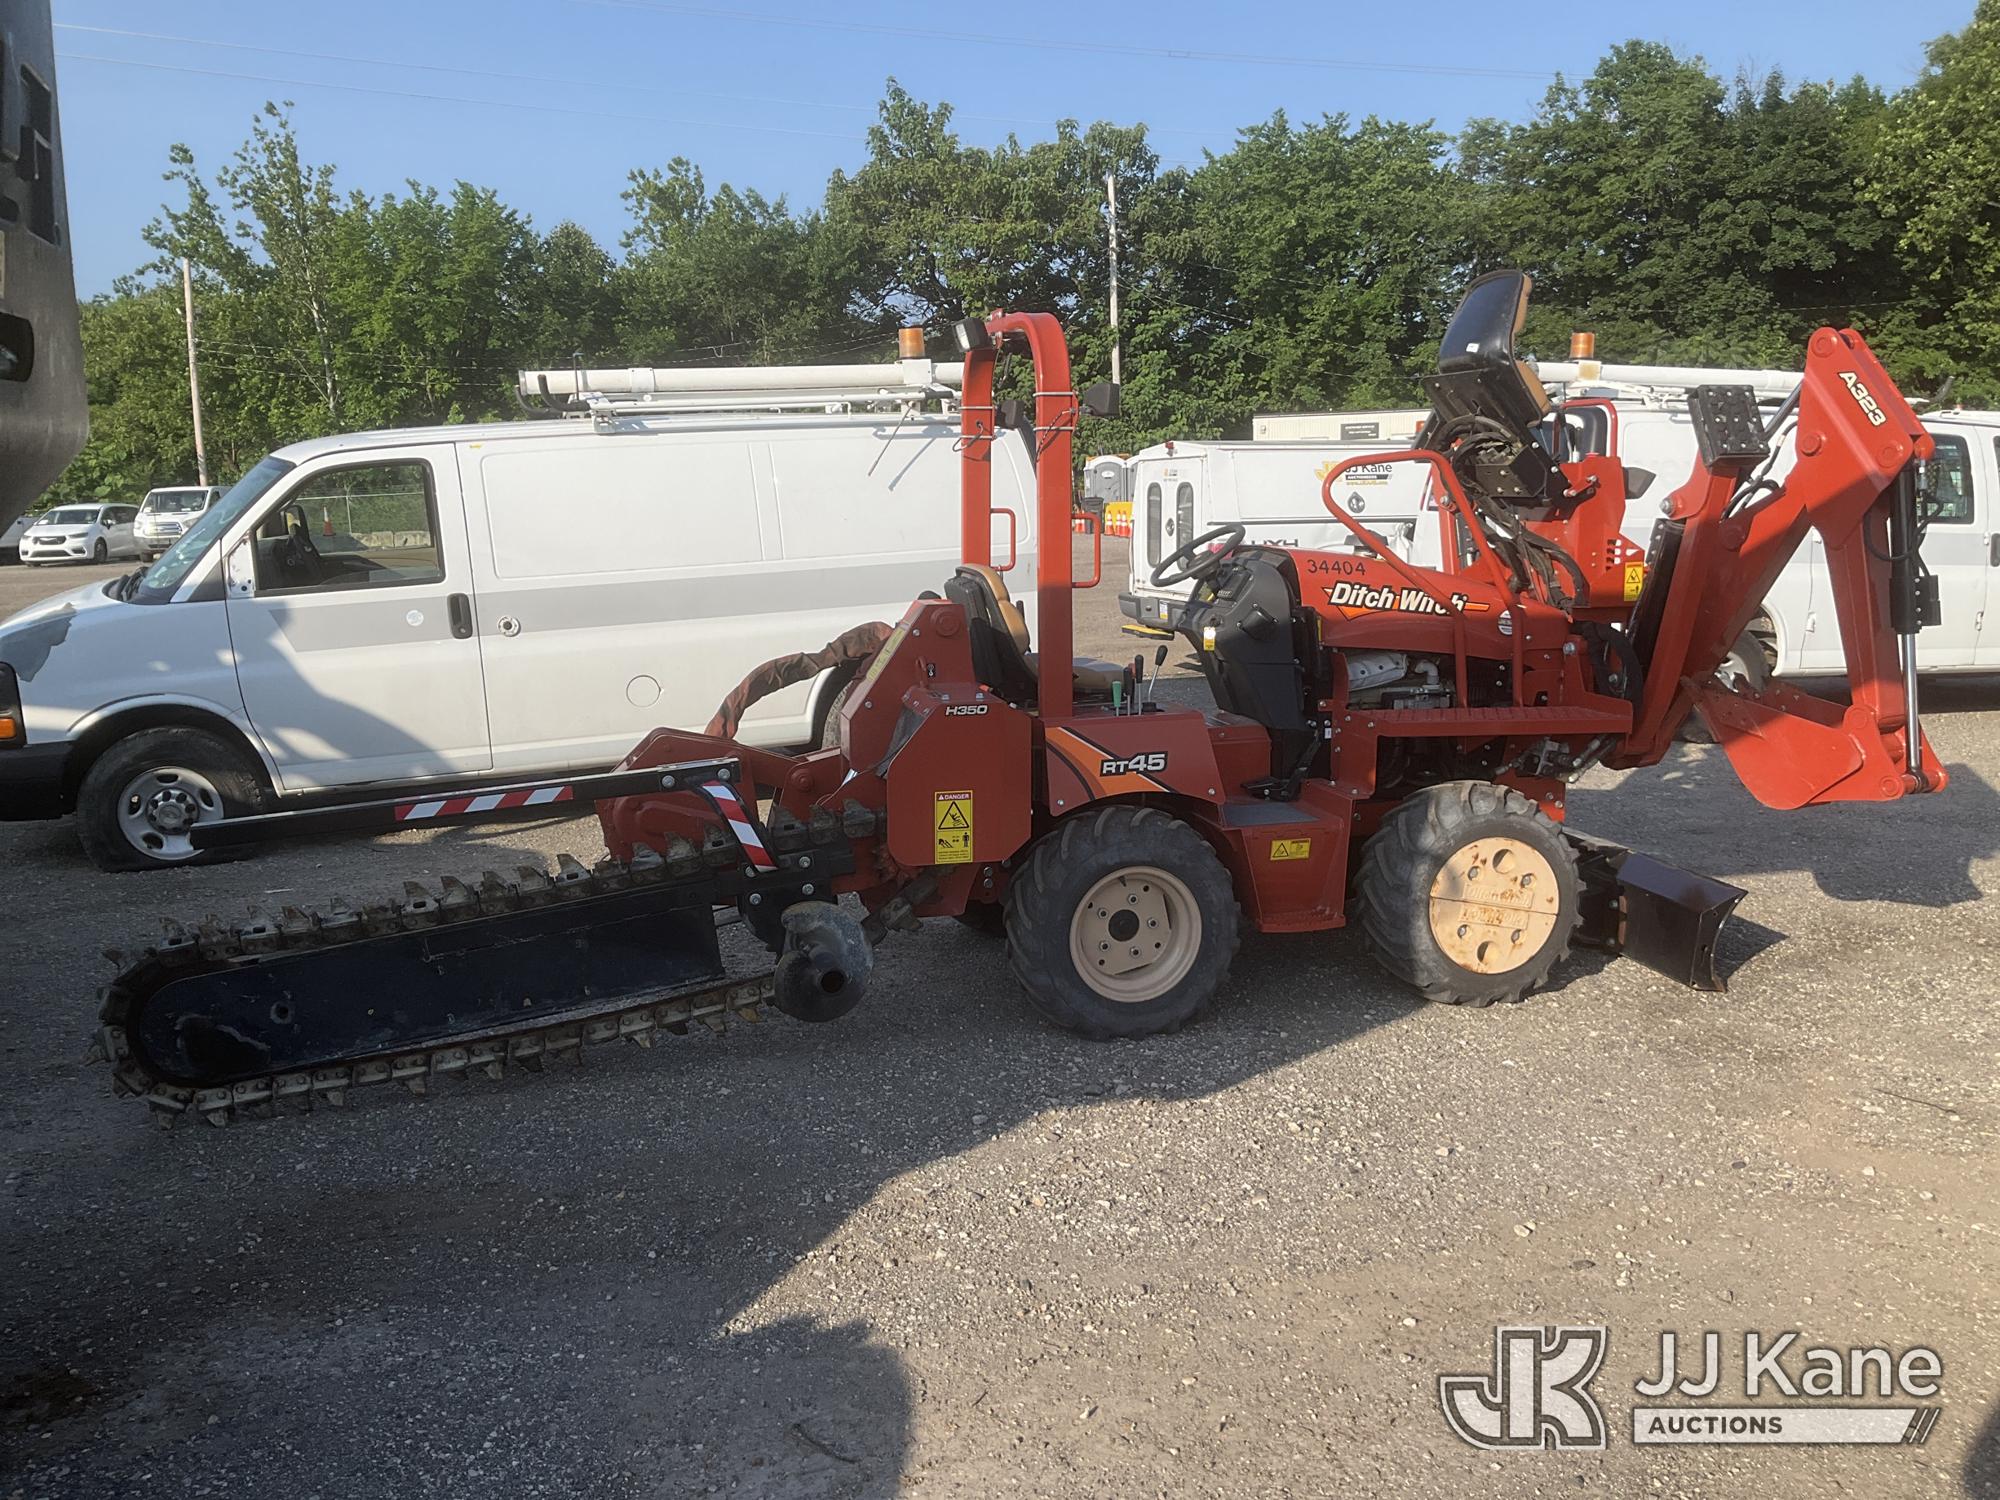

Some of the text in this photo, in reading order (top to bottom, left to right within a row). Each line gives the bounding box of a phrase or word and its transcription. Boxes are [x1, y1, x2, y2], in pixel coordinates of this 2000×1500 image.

[1837, 371, 1887, 426] A323
[1361, 463, 1393, 473] Kane
[1307, 559, 1366, 576] 34404
[1329, 582, 1395, 609] Ditch
[945, 704, 988, 716] H350
[1102, 752, 1166, 775] RT45
